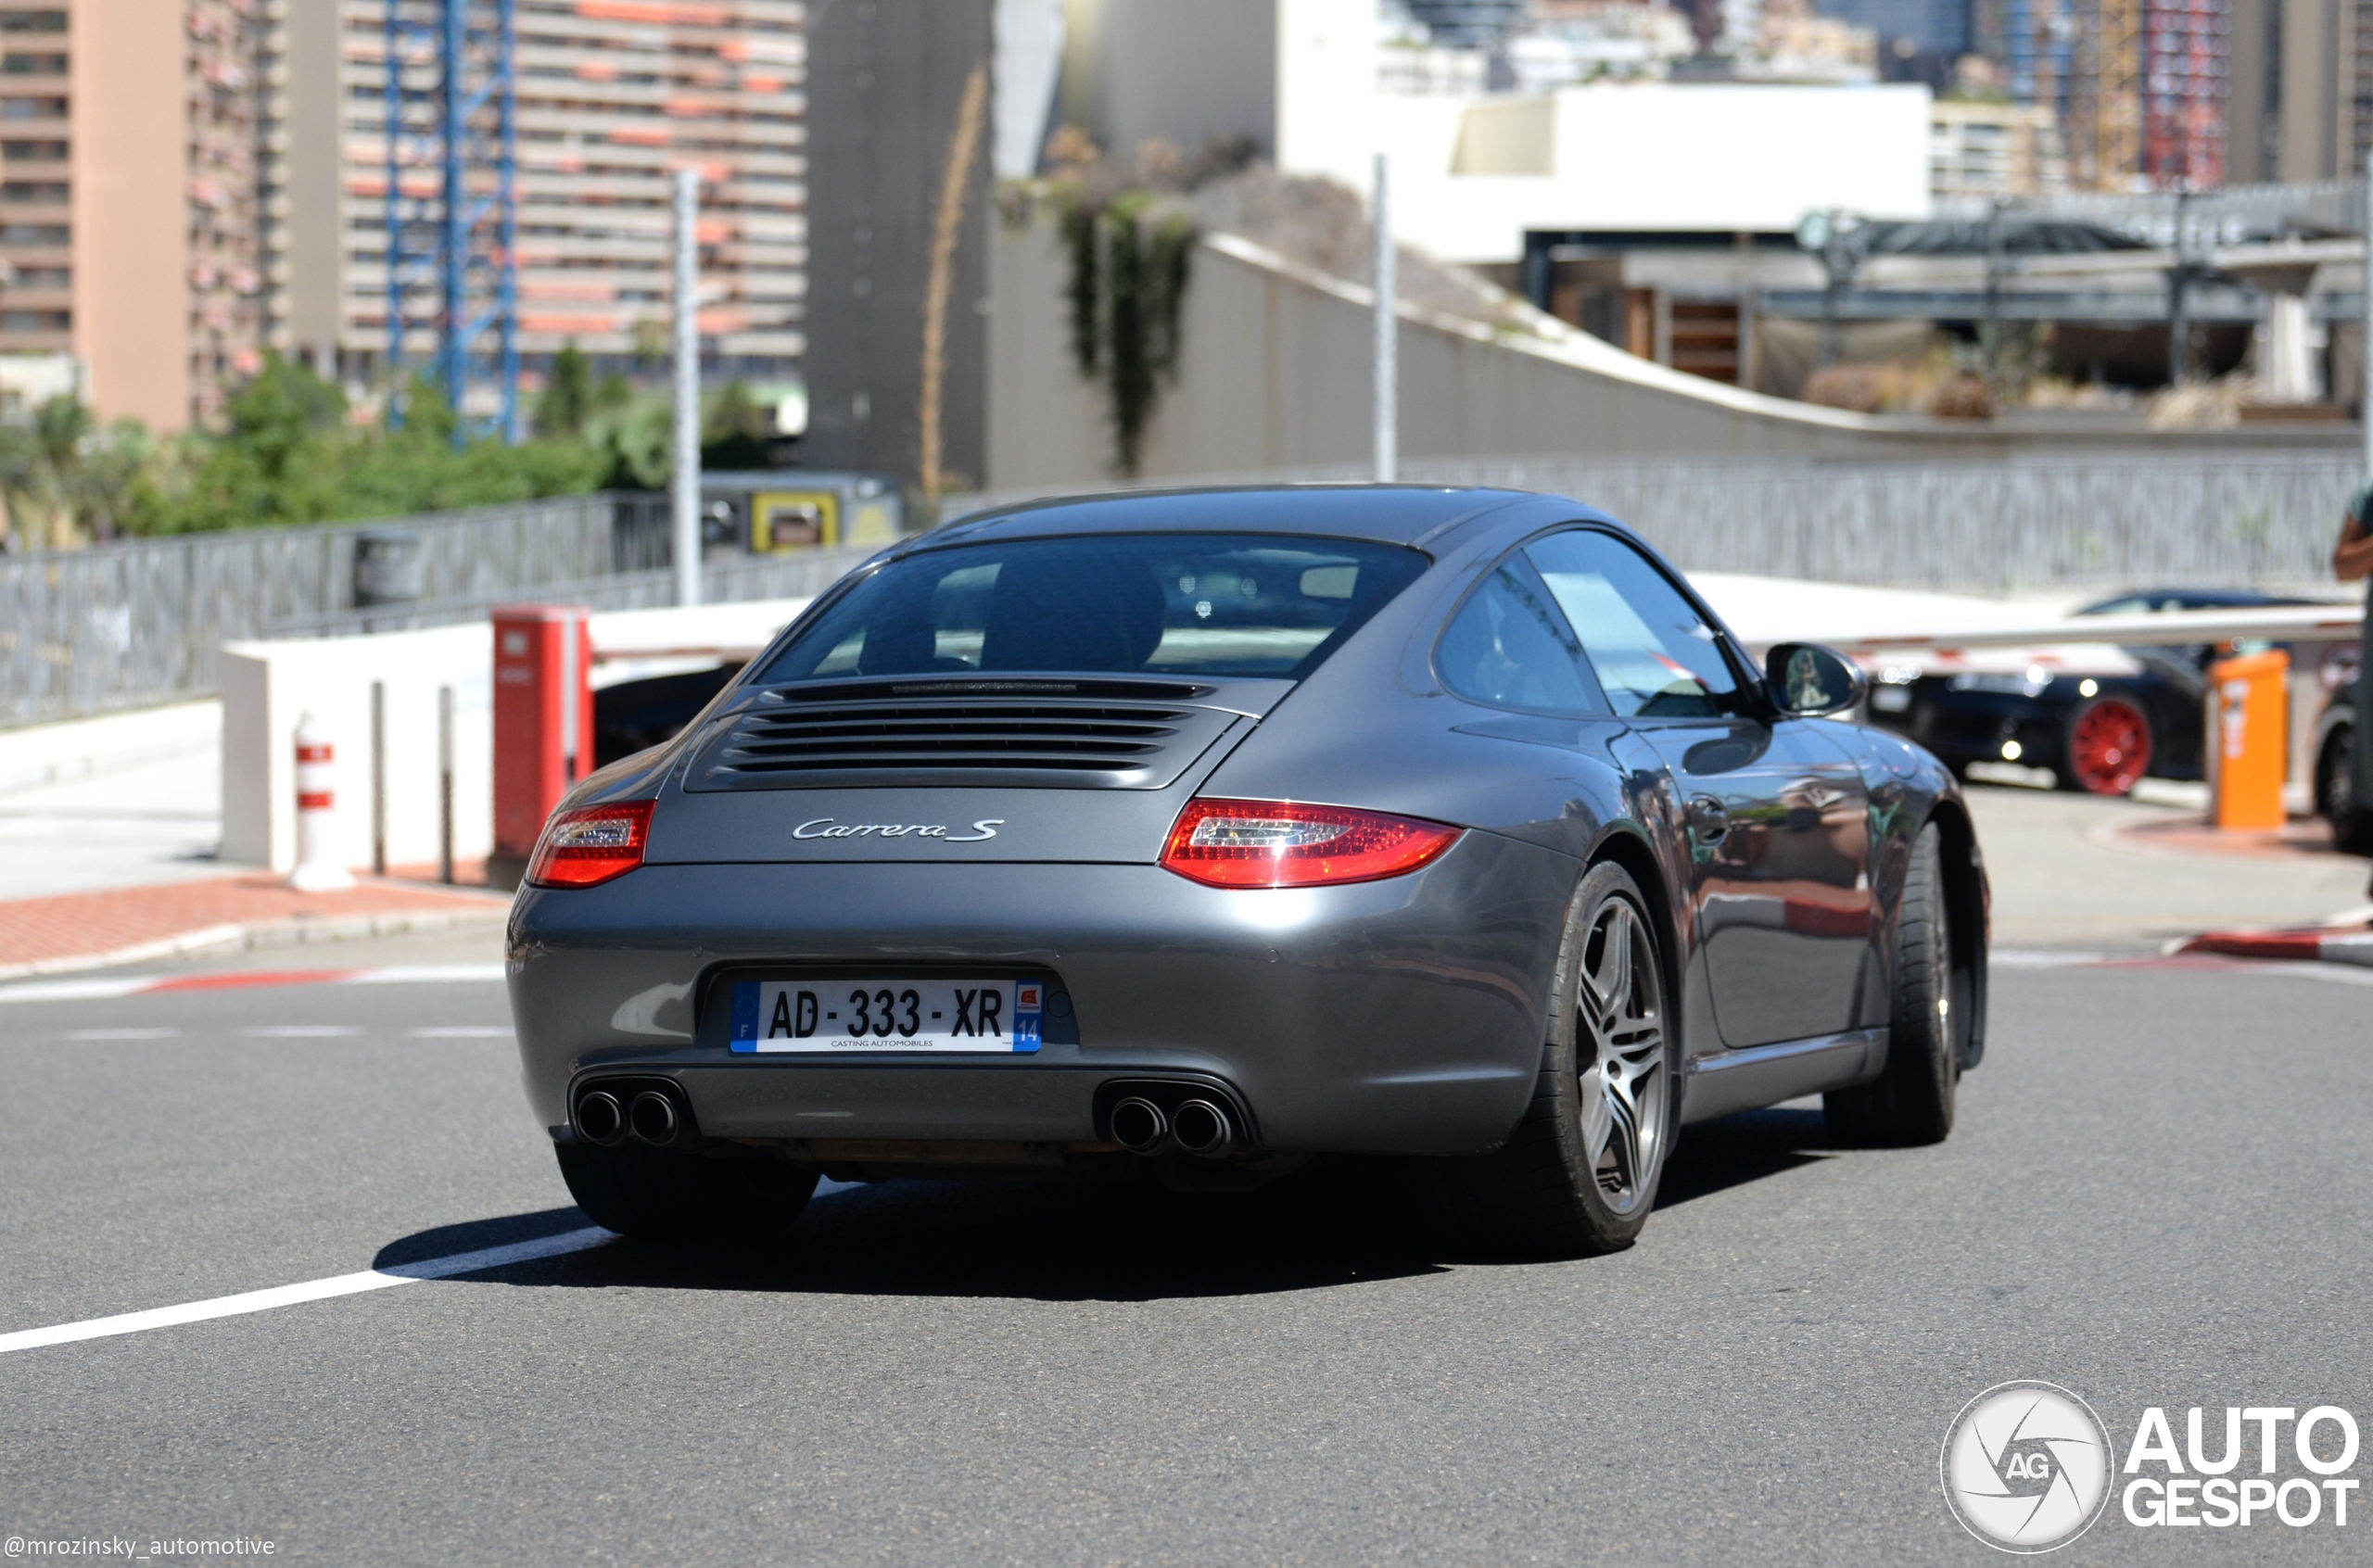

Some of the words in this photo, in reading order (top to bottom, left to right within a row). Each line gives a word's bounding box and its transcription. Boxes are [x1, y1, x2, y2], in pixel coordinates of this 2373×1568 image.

[792, 818, 946, 840] Carrera
[944, 819, 1005, 842] S
[740, 1024, 749, 1038] F
[1019, 1019, 1038, 1042] 14
